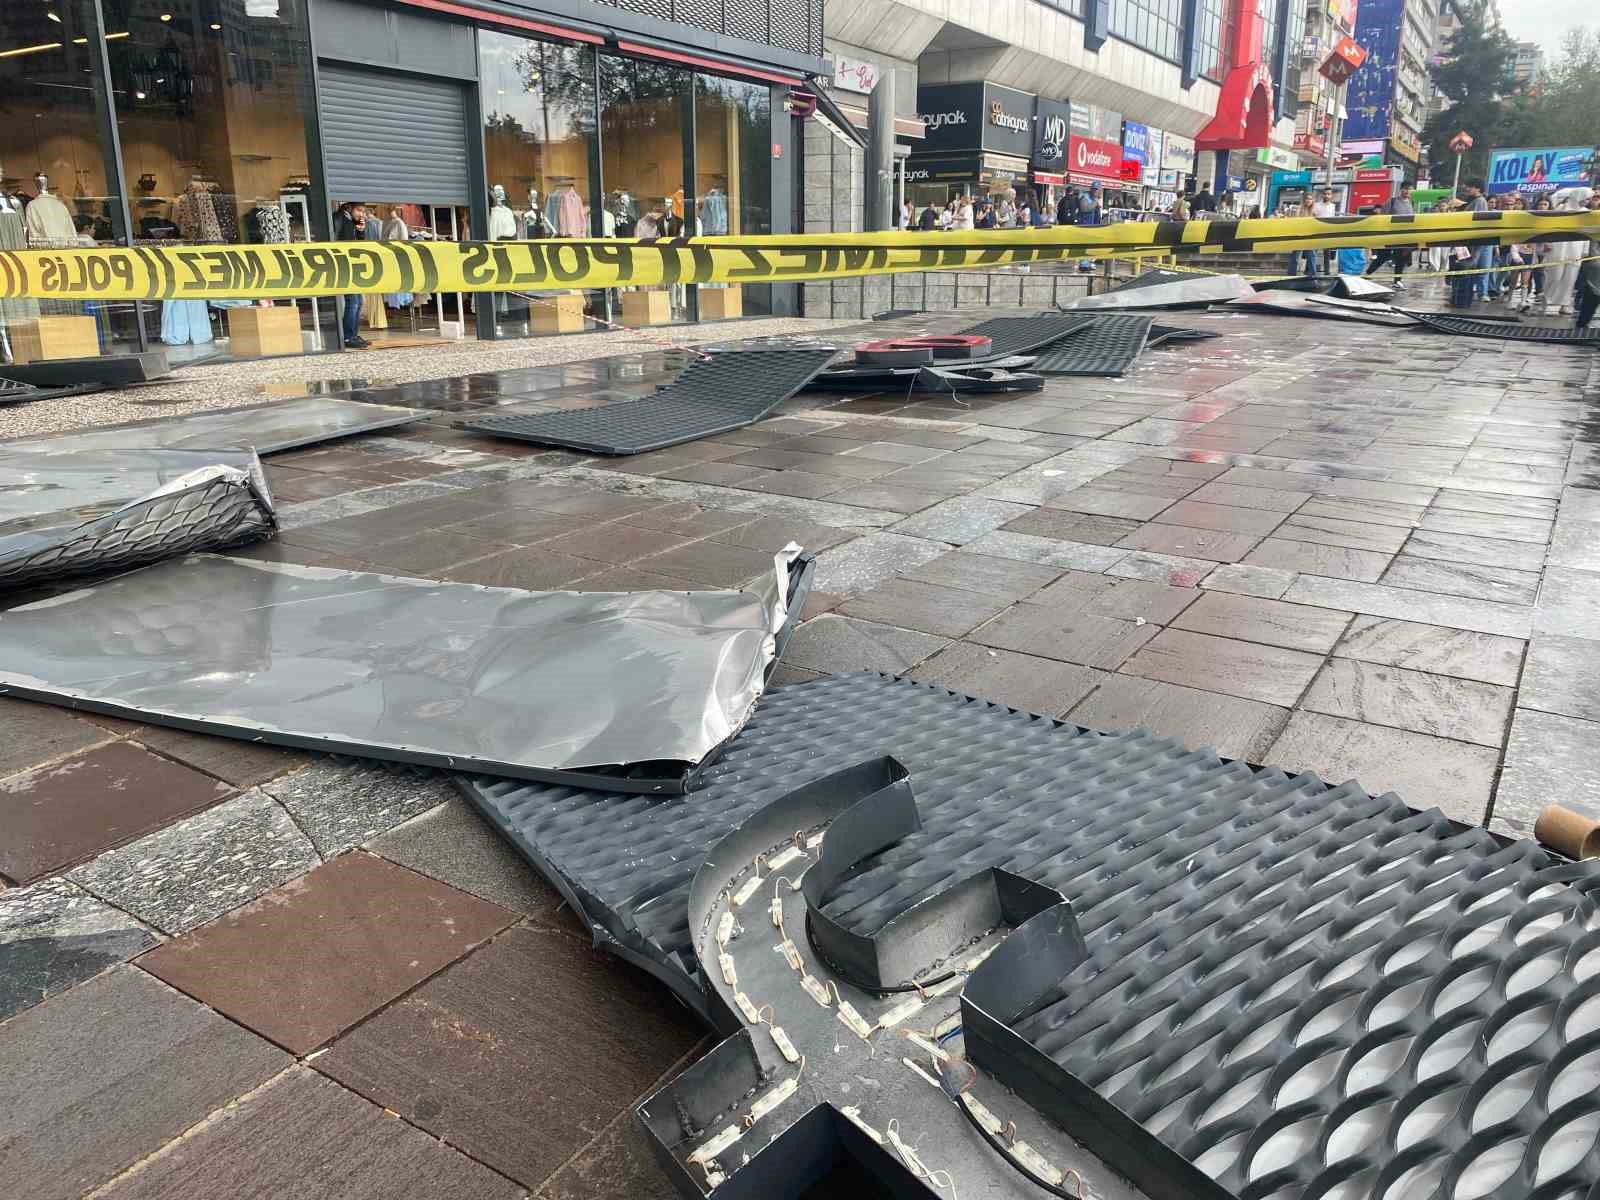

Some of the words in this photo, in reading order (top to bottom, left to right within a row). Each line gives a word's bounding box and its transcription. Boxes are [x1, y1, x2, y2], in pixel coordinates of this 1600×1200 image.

[1344, 45, 1360, 57] M
[1328, 62, 1345, 76] M
[920, 110, 966, 130] aynak
